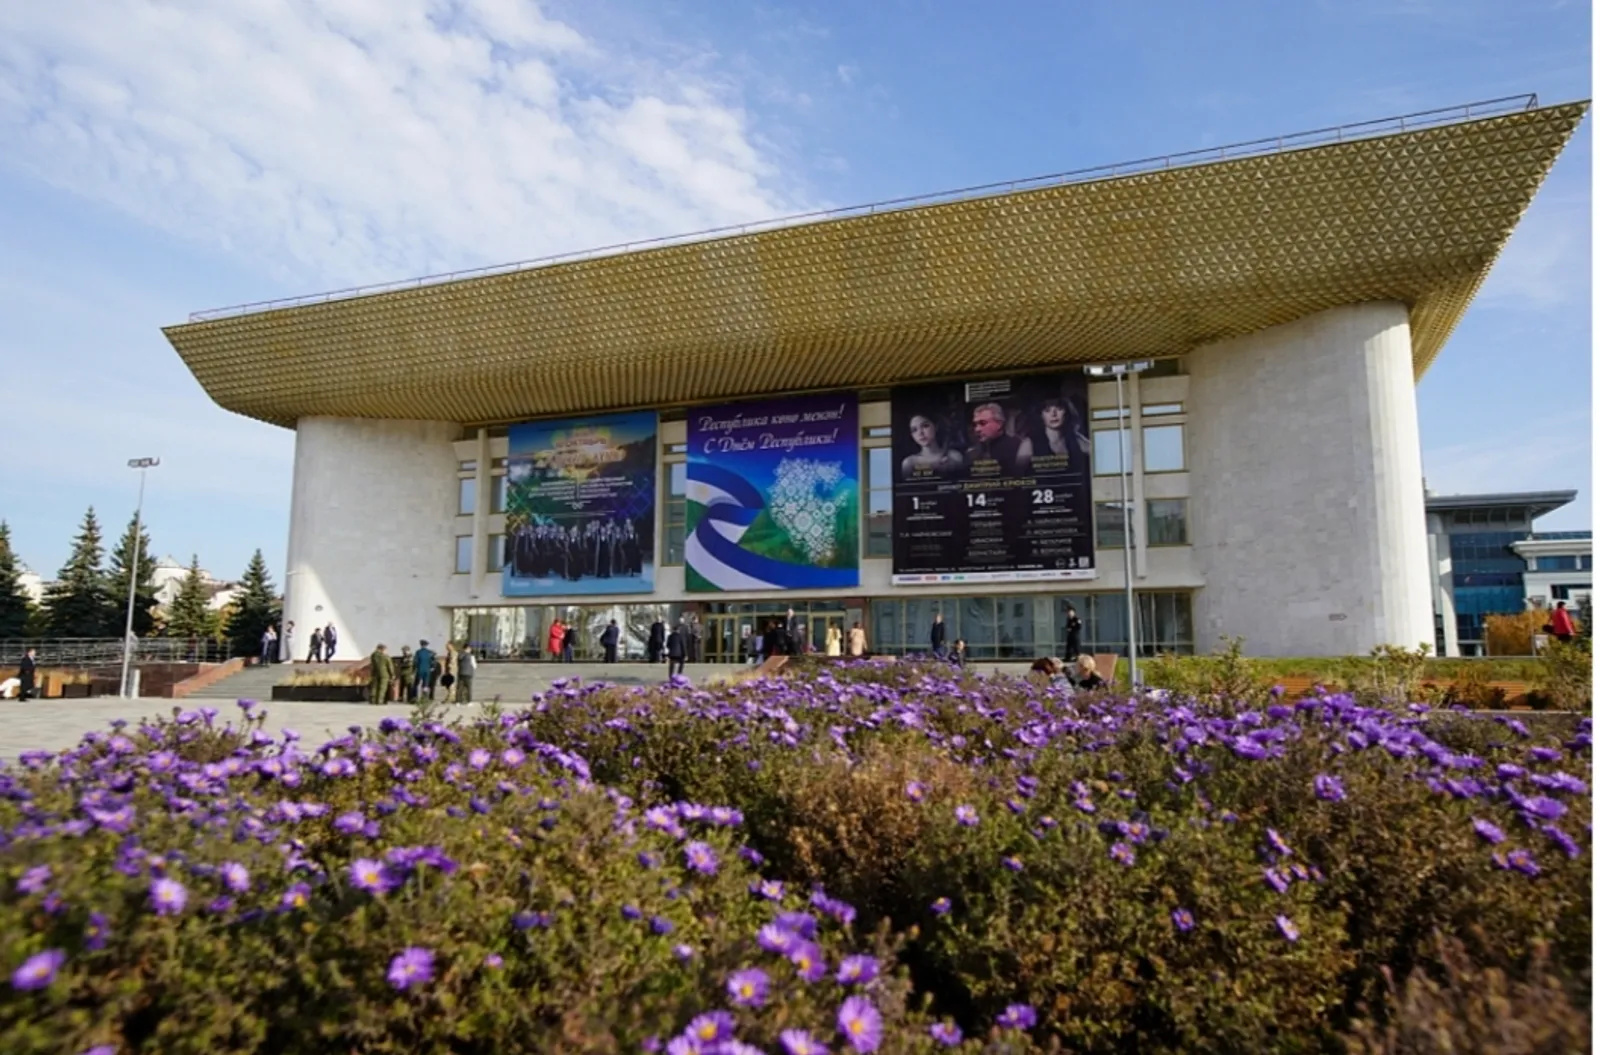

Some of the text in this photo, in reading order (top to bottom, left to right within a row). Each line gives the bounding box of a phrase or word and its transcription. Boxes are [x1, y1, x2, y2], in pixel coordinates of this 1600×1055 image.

[699, 412, 768, 435] Республика
[703, 428, 839, 454] С Днём Республики!
[912, 497, 919, 510] 1
[966, 493, 987, 507] 14
[1032, 489, 1054, 504] 28
